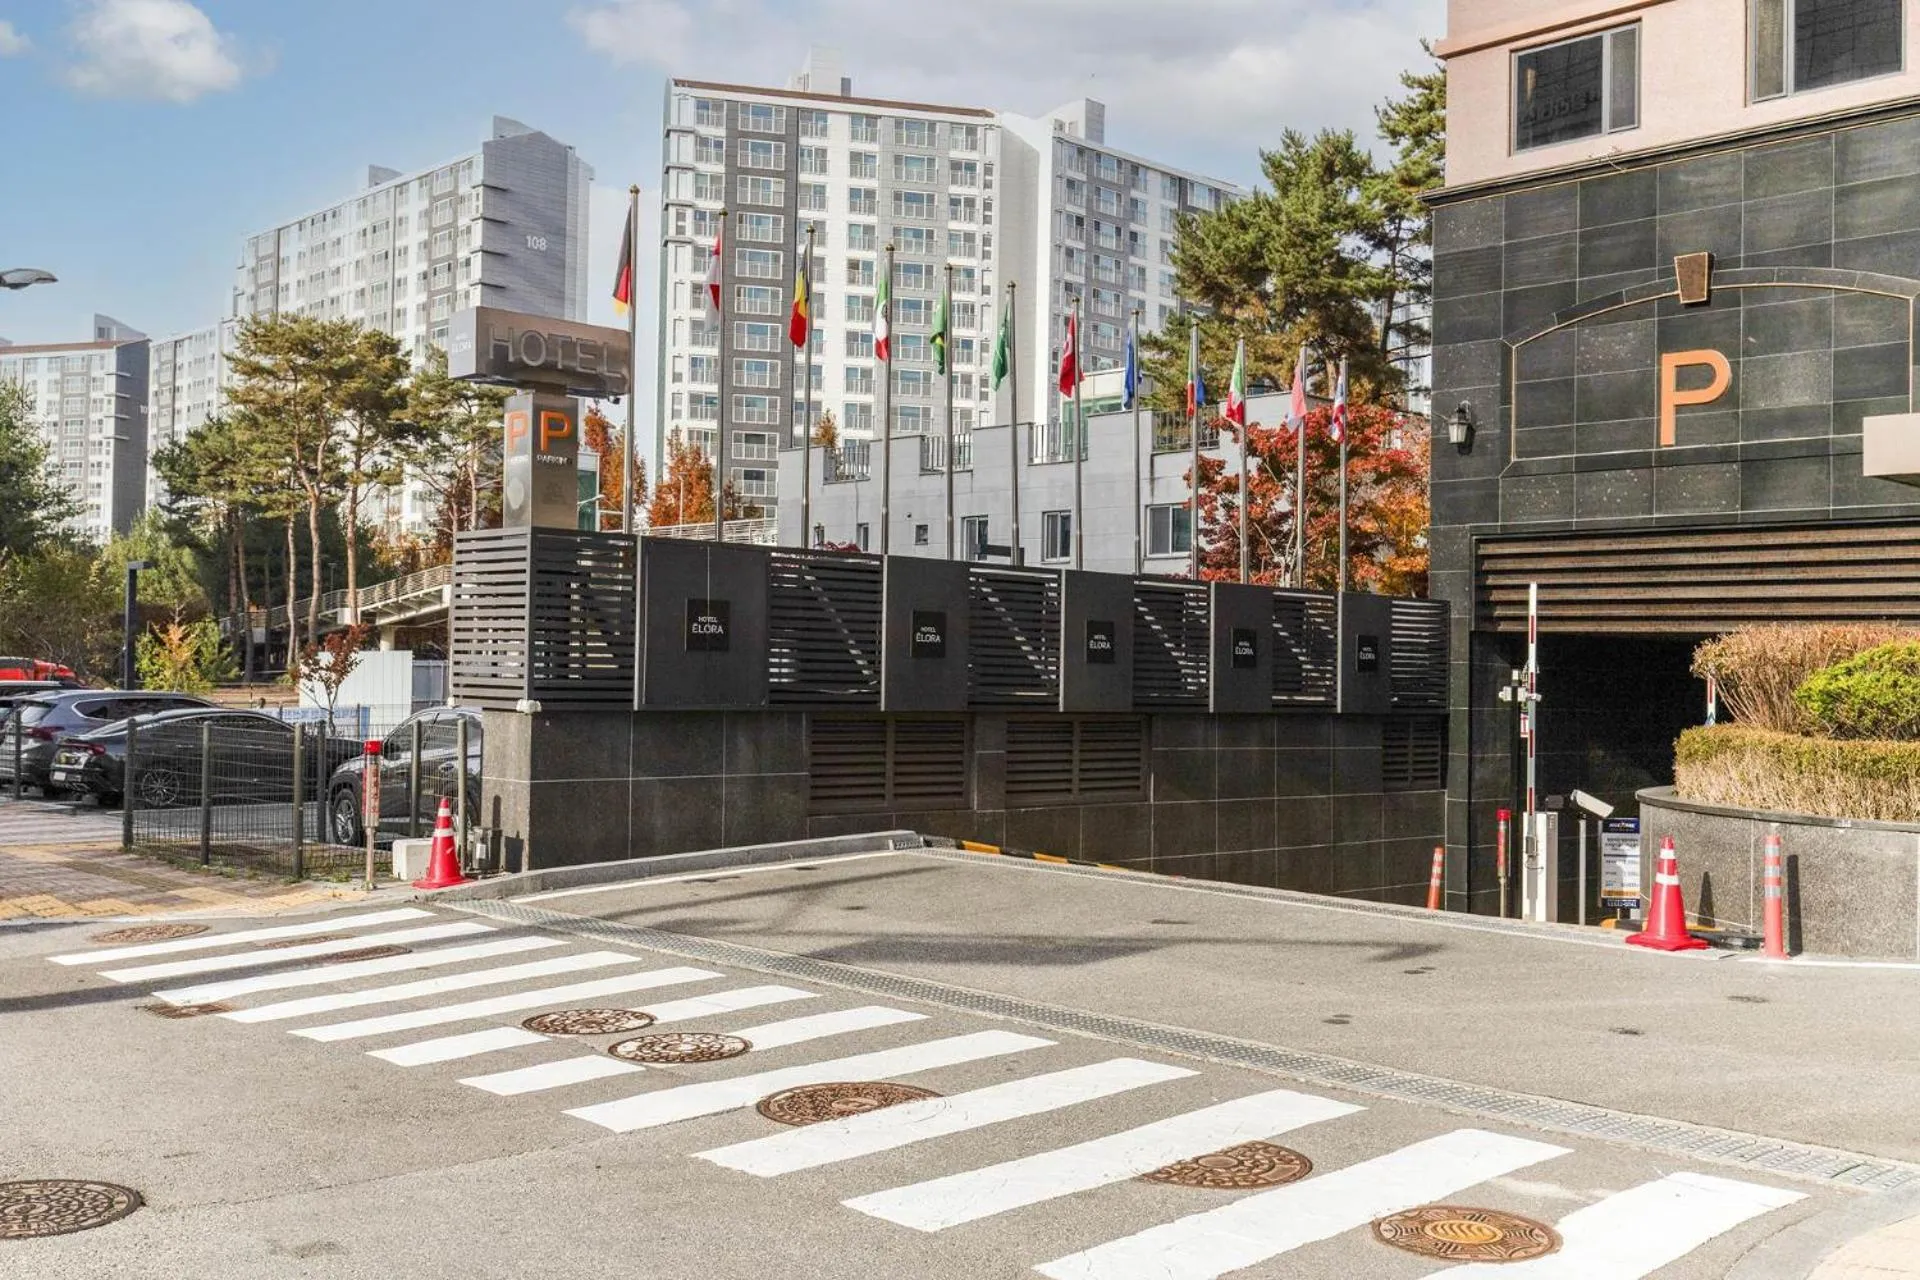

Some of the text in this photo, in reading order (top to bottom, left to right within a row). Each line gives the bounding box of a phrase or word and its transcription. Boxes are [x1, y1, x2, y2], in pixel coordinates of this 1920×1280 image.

[526, 235, 546, 251] 108
[488, 326, 624, 378] HOTEL
[1660, 349, 1732, 446] P
[505, 409, 529, 454] P
[540, 408, 572, 453] P
